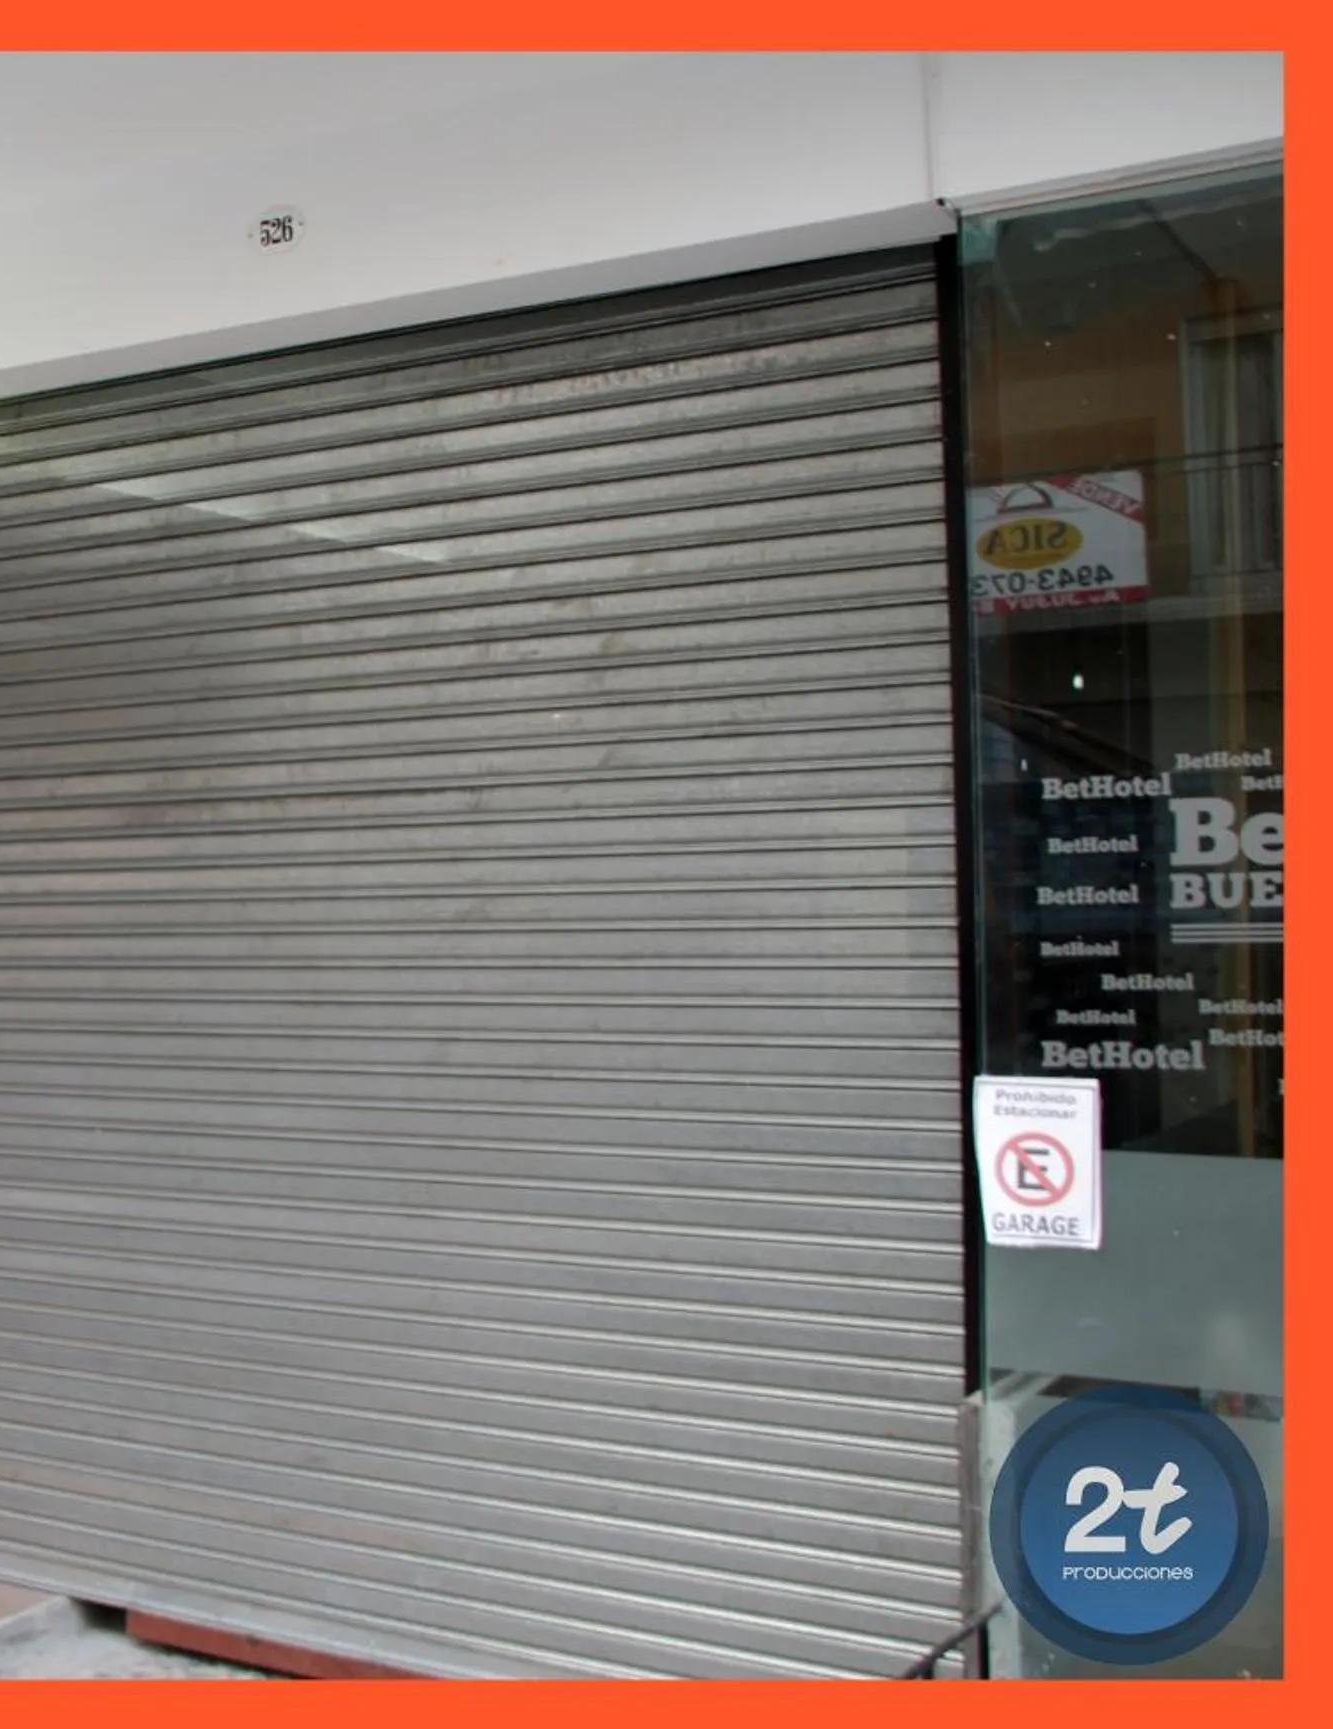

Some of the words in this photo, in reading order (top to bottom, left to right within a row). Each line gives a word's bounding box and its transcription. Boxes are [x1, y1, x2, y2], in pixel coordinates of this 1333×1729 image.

[260, 215, 293, 246] 526
[1175, 748, 1272, 770] BetHotel
[1041, 773, 1172, 800] BetHotel
[1170, 796, 1284, 867] Be
[1047, 835, 1139, 854] BetHotel
[1037, 884, 1140, 905] BetHotel
[1170, 871, 1284, 908] BUE
[1040, 941, 1120, 957] BetHotel
[1101, 973, 1195, 991] BetHotel
[1056, 1010, 1136, 1025] BetHotel
[1199, 999, 1283, 1015] BetHotel
[1041, 1039, 1205, 1070] BetHotel
[996, 1088, 1077, 1105] Prohibido
[994, 1105, 1077, 1119] Estacionar
[992, 1213, 1080, 1236] GARAGE
